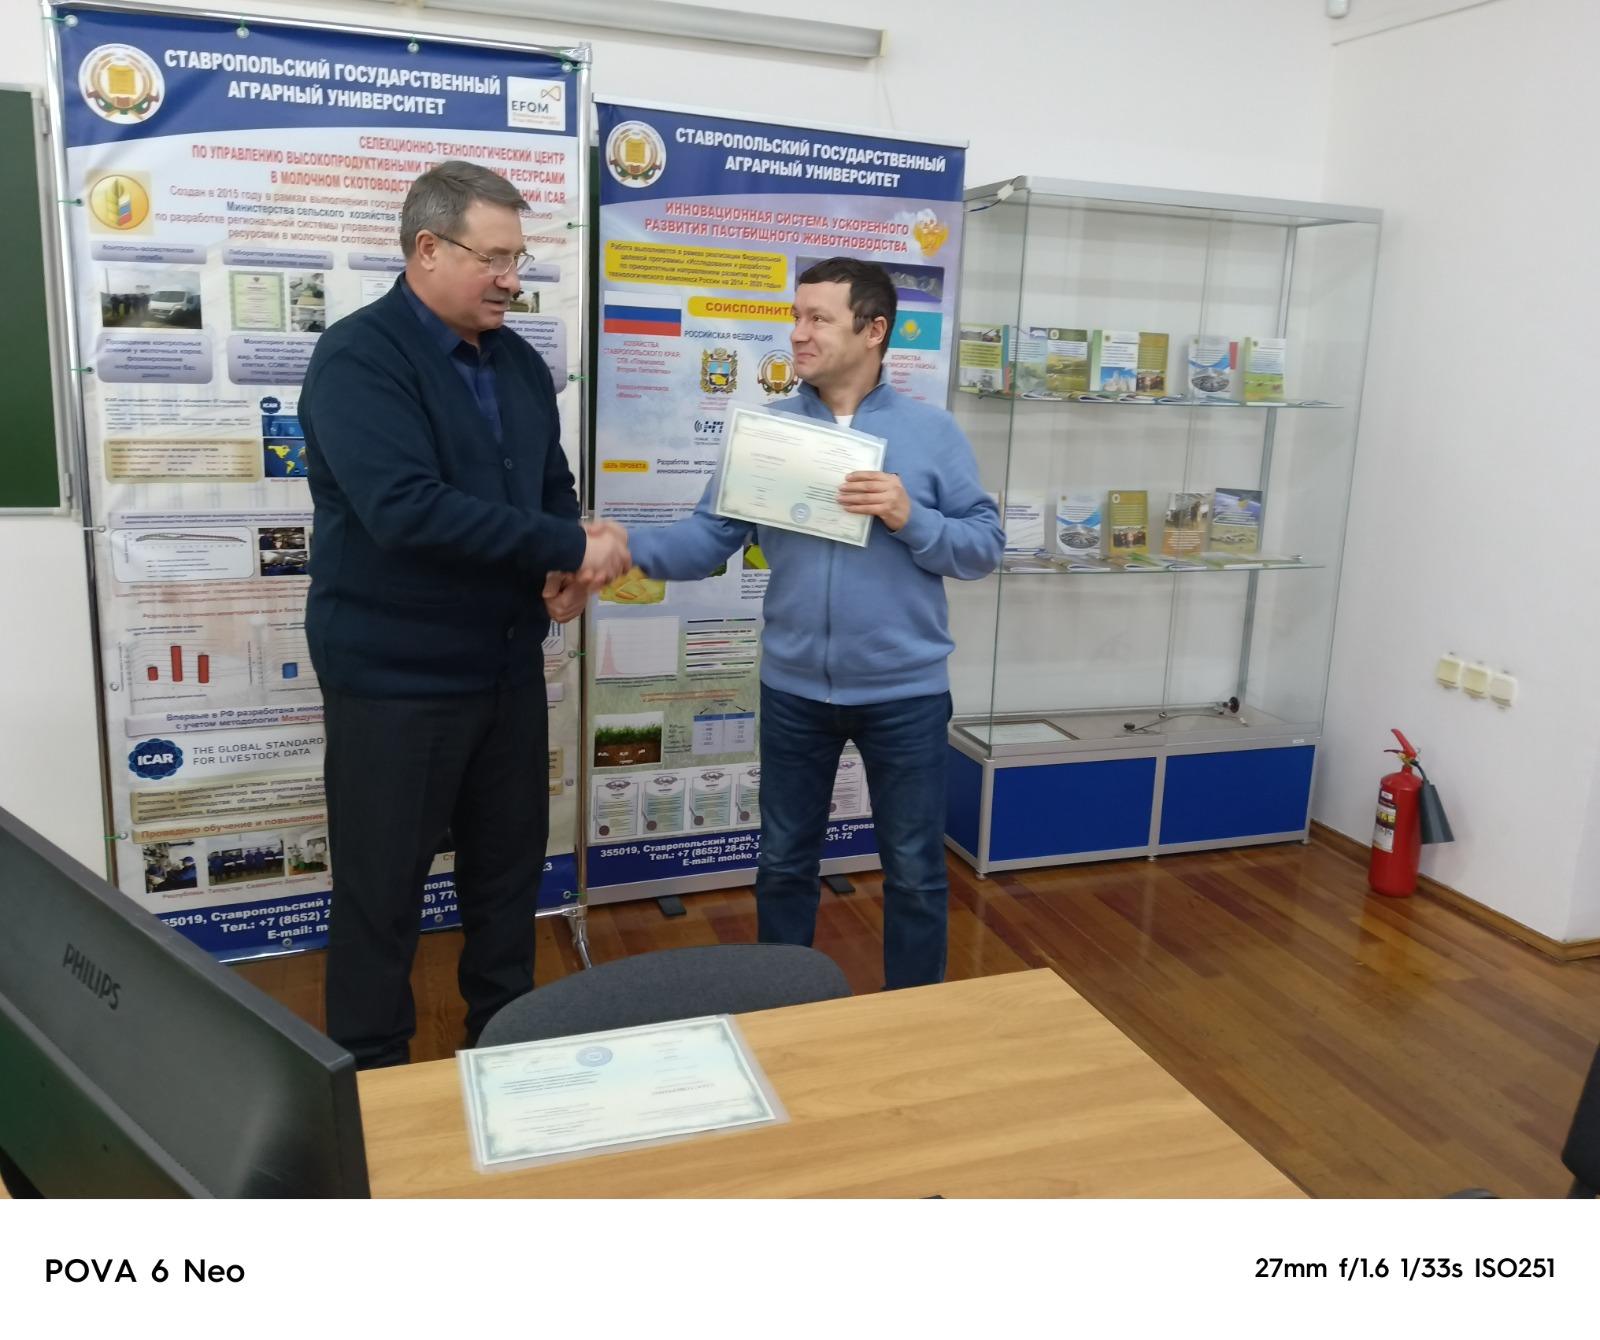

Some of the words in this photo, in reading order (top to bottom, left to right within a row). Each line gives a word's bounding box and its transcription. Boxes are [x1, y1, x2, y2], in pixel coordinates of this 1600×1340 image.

[164, 49, 331, 81] СТАВРОПОЛЬСКИЙ
[334, 63, 501, 96] ГОСУДАРСТВЕННЫЙ
[228, 81, 324, 106] АГРАРНЫЙ
[327, 89, 447, 116] УНИВЕРСИТЕТ
[511, 100, 549, 114] EFQM
[191, 145, 208, 158] ПО
[210, 146, 283, 164] УПРАВЛЕНИЮ
[287, 151, 421, 173] ВЫСОКОПРОДУКТИВНЫМИ
[359, 135, 532, 162] СЕЛЕКЦИОННО-ТЕХНОЛОГИЧЕСКИЙ
[534, 151, 565, 165] ЦЕНТР
[675, 127, 810, 157] СТАВРОПОЛЬСКИЙ
[812, 143, 946, 172] ГОСУДАРСТВЕННЫЙ
[271, 171, 278, 184] В
[281, 172, 341, 189] МОЛОЧНОМ
[343, 175, 416, 193] СКОТОВОДСТ
[510, 168, 566, 185] РЕСУРСАМИ
[725, 155, 803, 178] АГРАРНЫЙ
[805, 164, 901, 188] УНИВЕРСИТЕТ
[170, 185, 206, 197] Создан
[208, 189, 214, 198] в
[217, 187, 239, 199] 2015
[241, 191, 262, 202] году
[265, 192, 271, 200] в
[273, 193, 307, 203] рамках
[309, 195, 368, 207] выполнения
[544, 190, 566, 204] ICAR
[226, 201, 295, 215] Министерства
[297, 207, 344, 218] сельского
[349, 210, 396, 221] хозяйства
[665, 202, 774, 224] ИННОВАЦИОННАЯ
[776, 212, 829, 229] СИСТЕМА
[832, 217, 909, 235] УСКОРЕННОГО
[155, 213, 167, 221] по
[170, 212, 224, 224] разработке
[227, 216, 295, 227] региональной
[297, 220, 338, 230] системы
[341, 223, 395, 234] управления
[228, 229, 279, 240] ресурсами
[282, 232, 288, 240] в
[291, 232, 338, 243] молочном
[645, 218, 709, 236] РАЗВИТИЯ
[711, 224, 800, 245] ПАСТБИЩНОГО
[803, 232, 909, 253] ЖИВОТНОВОДСТВА
[683, 329, 731, 341] РОССИЙСКАЯ
[732, 332, 774, 342] ФЕДЕРАЦИЯ
[166, 713, 209, 722] Впервые
[220, 710, 234, 718] РФ
[237, 707, 295, 718] разработана
[183, 721, 217, 731] учетом
[219, 717, 279, 727] методологии
[193, 747, 215, 755] THE
[218, 743, 262, 754] GLOBAL
[266, 737, 324, 749] STANDARD
[193, 757, 215, 766] FOR
[219, 752, 281, 764] LIVESTOCK
[284, 748, 312, 757] DATA
[137, 753, 174, 767] ICAR
[141, 825, 201, 839] Проведено
[203, 819, 253, 833] обучение
[264, 813, 325, 827] повышение
[826, 826, 840, 835] ул.
[842, 822, 875, 832] Серова
[600, 845, 641, 858] 355019,
[643, 837, 726, 853] Ставропольский
[728, 833, 755, 845] край,
[649, 852, 675, 861] Тел.:
[677, 849, 690, 858] +7
[691, 845, 723, 858] (8652)
[682, 856, 716, 867] E-mail:
[210, 899, 325, 922] Ставропольский
[220, 922, 256, 933] Тел.:
[259, 918, 275, 927] +7
[278, 911, 321, 927] (8652)
[267, 925, 313, 940] E-mail:
[62, 942, 122, 1011] PHILIPS
